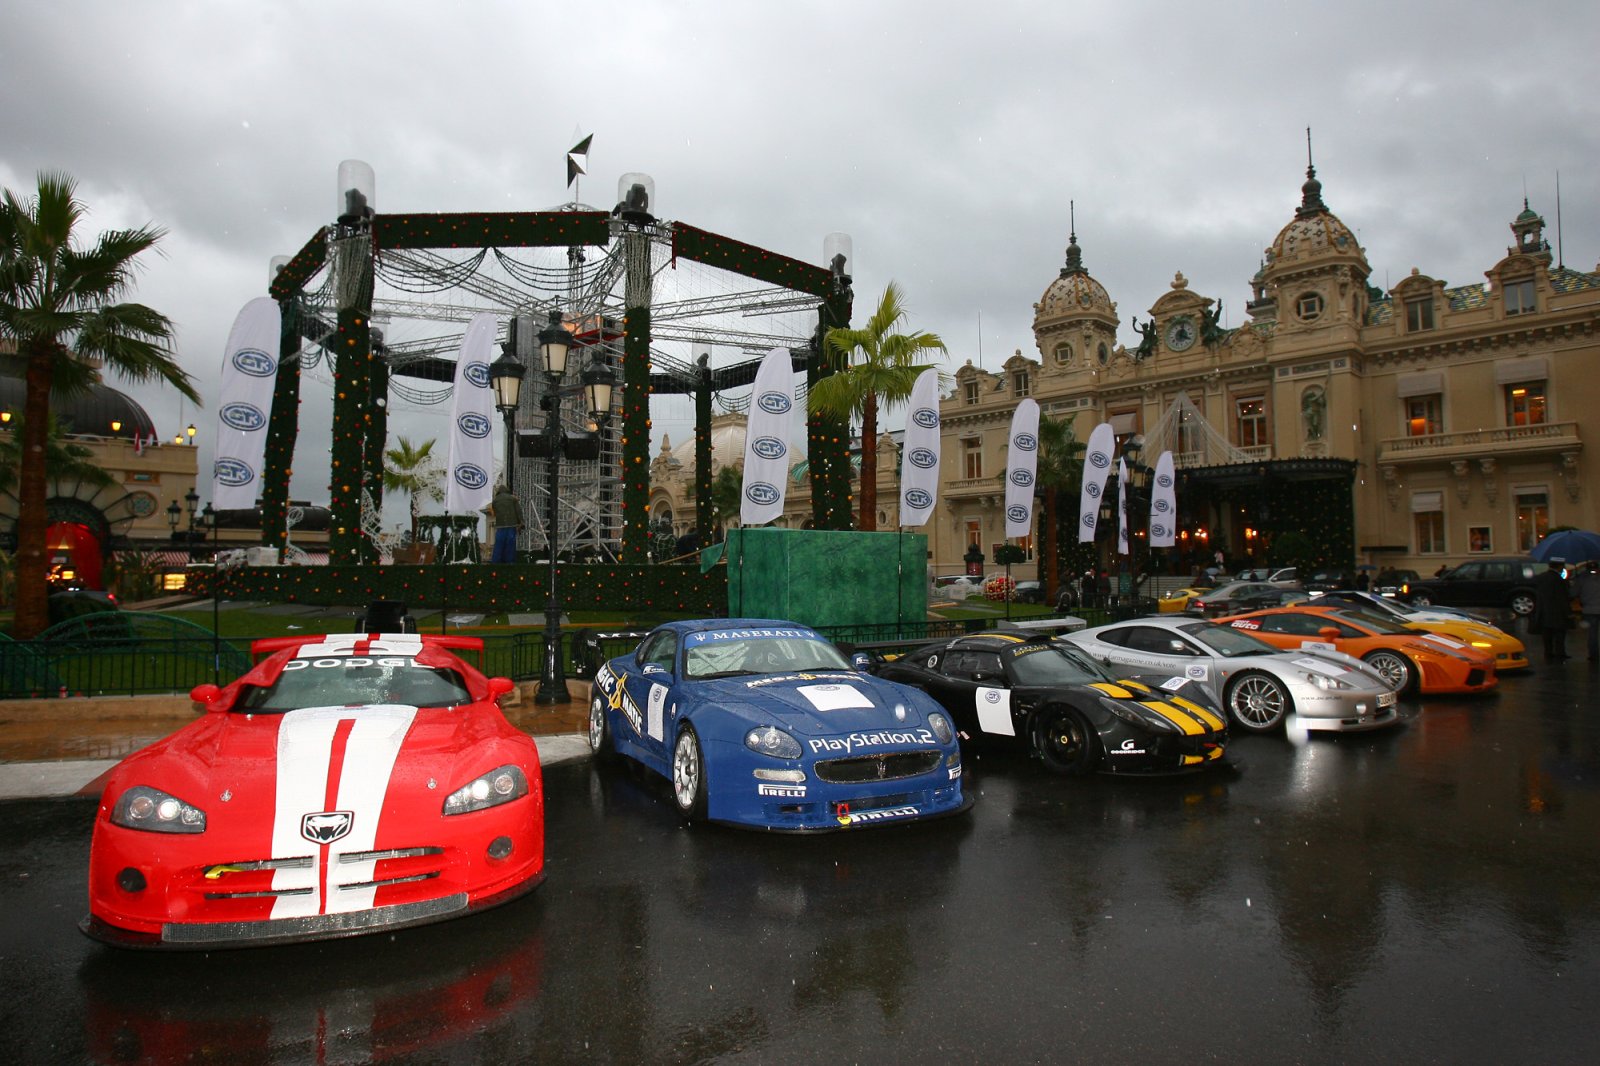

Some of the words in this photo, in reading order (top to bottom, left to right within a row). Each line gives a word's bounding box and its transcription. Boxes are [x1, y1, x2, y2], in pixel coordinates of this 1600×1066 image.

[713, 630, 802, 640] MASERATI
[758, 784, 807, 797] PIRELLI
[850, 806, 919, 822] PIRELLI
